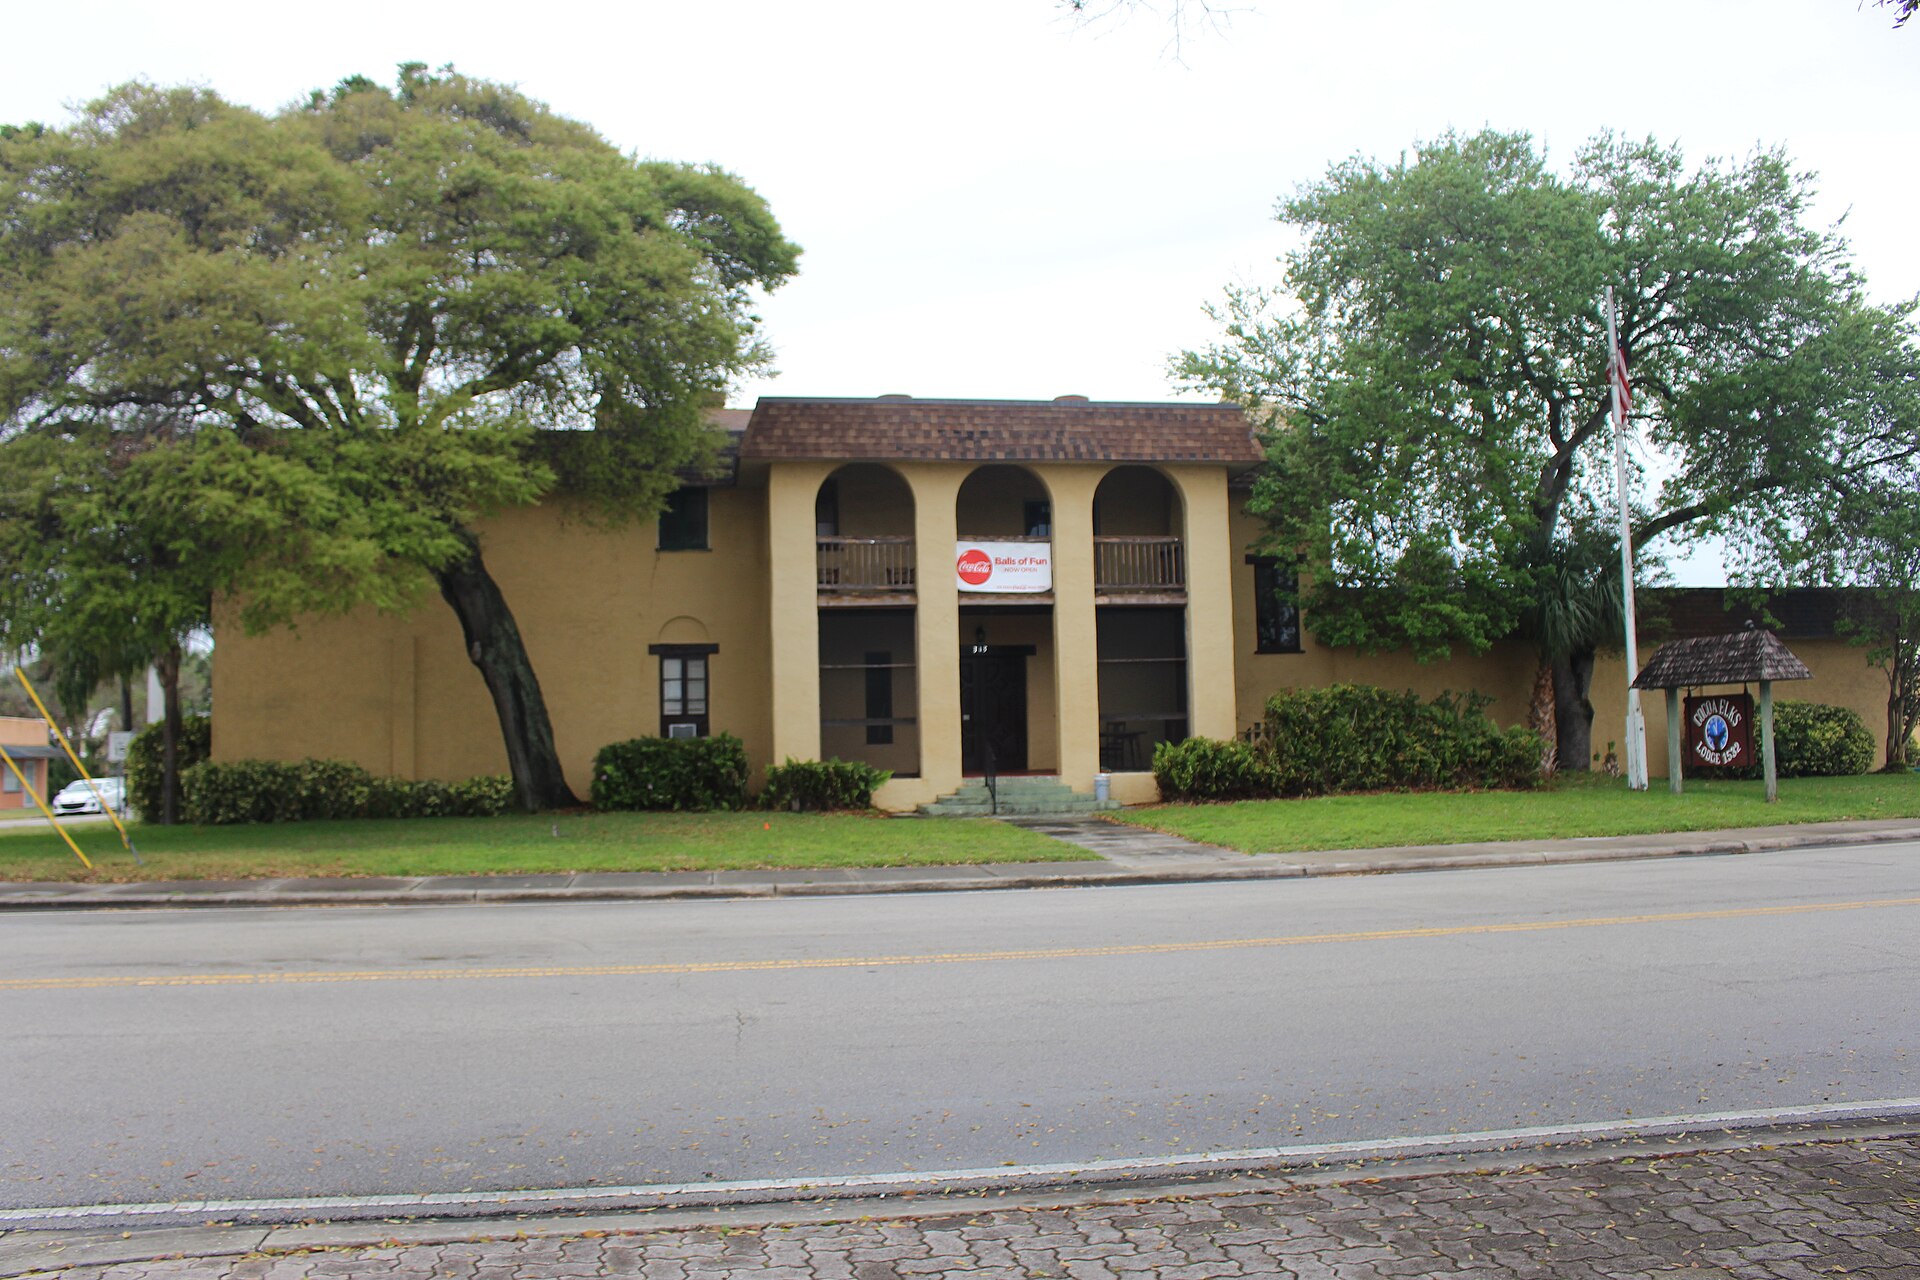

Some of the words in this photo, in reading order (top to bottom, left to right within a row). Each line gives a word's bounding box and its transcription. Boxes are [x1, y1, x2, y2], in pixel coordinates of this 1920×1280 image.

[995, 557, 1016, 565] Balls
[1018, 557, 1027, 565] of
[1030, 557, 1047, 565] Fun
[1693, 699, 1718, 727] COCOA
[1719, 698, 1742, 727] ELKS
[1696, 741, 1721, 765] LODGE
